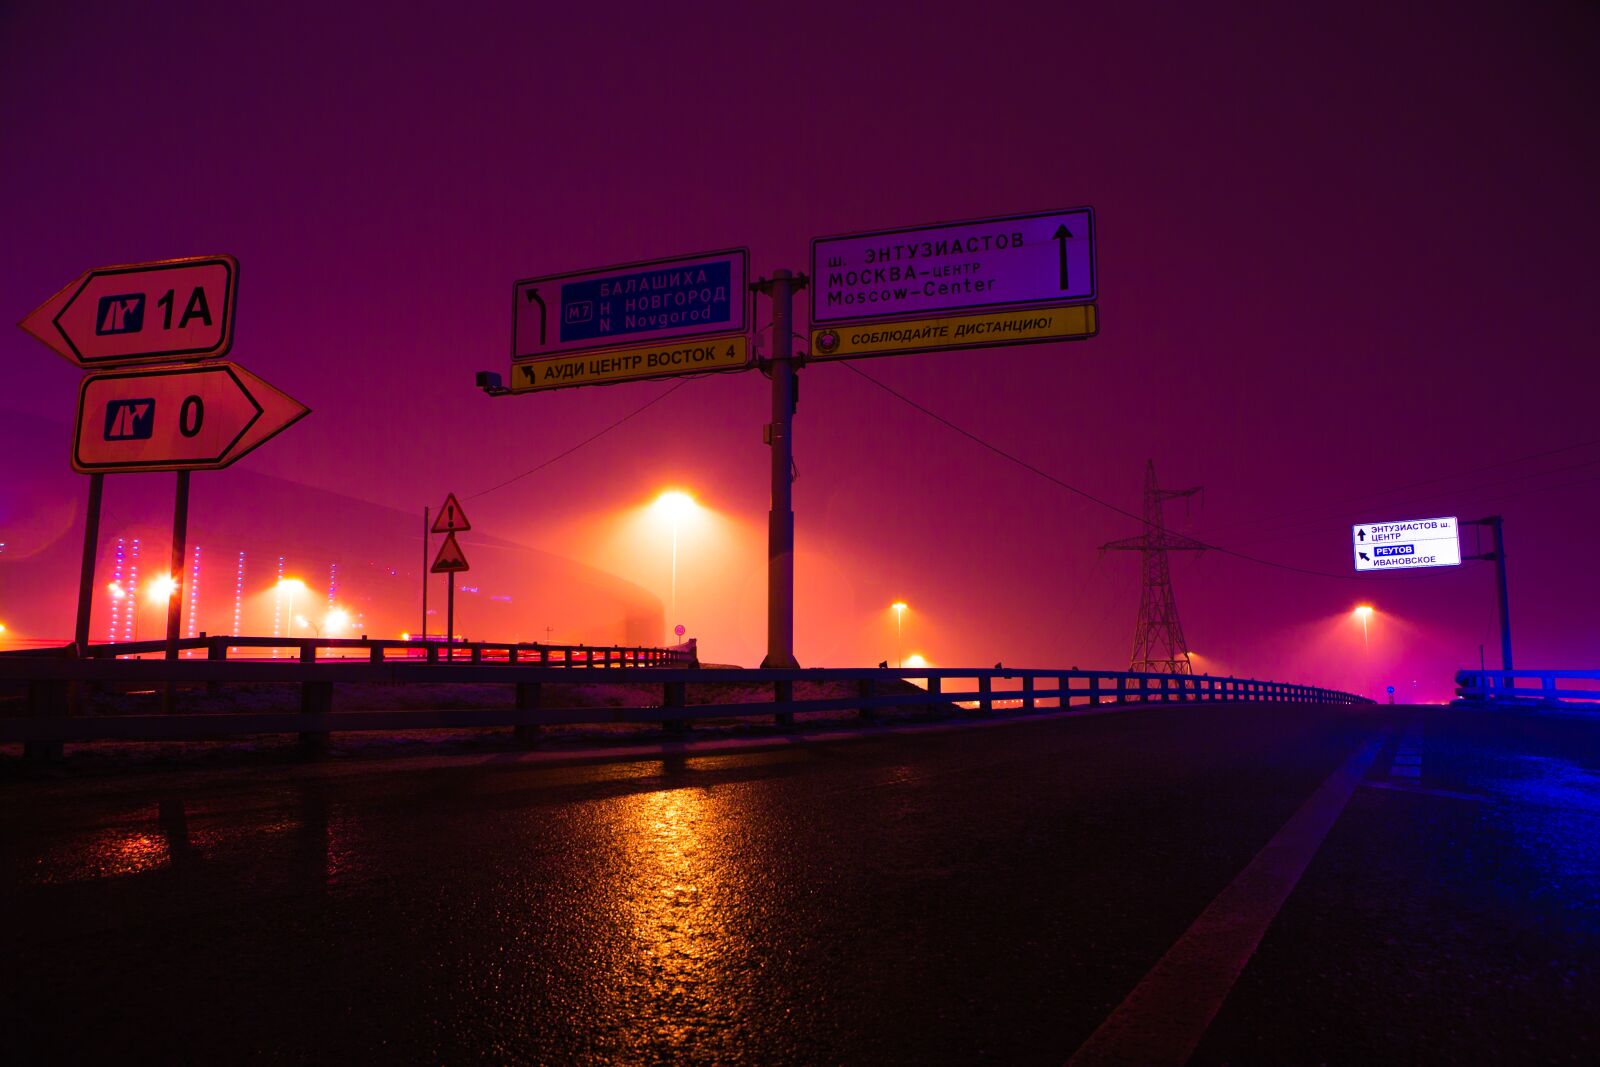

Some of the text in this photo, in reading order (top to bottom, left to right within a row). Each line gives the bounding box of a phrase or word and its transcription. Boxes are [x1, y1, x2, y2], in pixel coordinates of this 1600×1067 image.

[864, 232, 1025, 264] ЭНТУЗИАСТОВ
[599, 269, 709, 297] БАЛАШИХА
[827, 277, 996, 307] Moscow-Center
[625, 286, 727, 314] НОВГОРОД
[625, 305, 712, 329] Novgorod
[851, 317, 1053, 345] СОБЛЮДАЙТЕ ДИСТАНЦИЮ!
[544, 345, 736, 380] АУДИ ЦЕНТР ВОСТОК 4
[179, 395, 204, 438] 0
[1371, 522, 1437, 533] ЭНТУЗИАСТОВ
[1371, 533, 1401, 542] ЦЕНТР
[1373, 556, 1436, 566] ИВАНОВСКОЕ
[1376, 546, 1413, 555] РЕУТОВ
